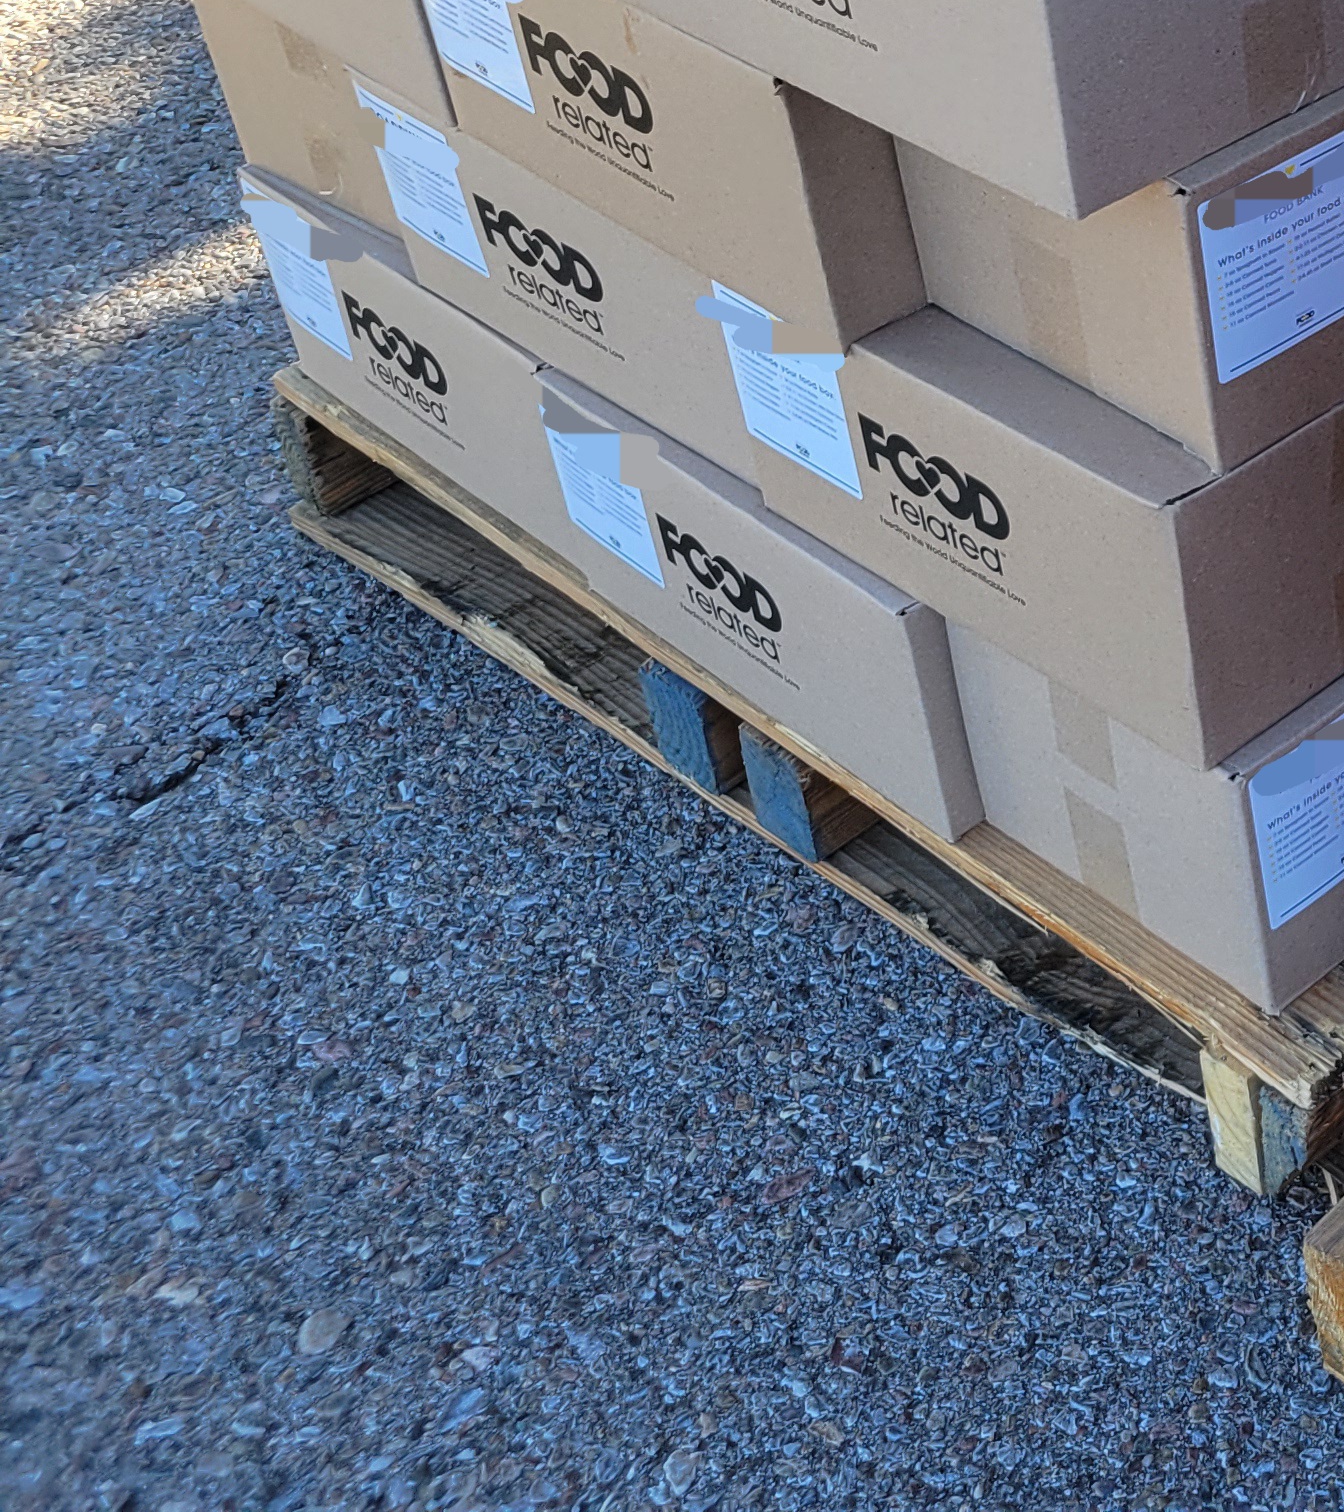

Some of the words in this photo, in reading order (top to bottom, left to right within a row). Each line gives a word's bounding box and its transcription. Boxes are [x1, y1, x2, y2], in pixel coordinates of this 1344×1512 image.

[518, 13, 653, 134] FOOD
[553, 95, 653, 172] related
[472, 193, 603, 302] FOOD
[1217, 246, 1254, 268] What's
[1257, 227, 1288, 249] inside
[1291, 212, 1314, 232] your
[1317, 199, 1341, 217] food
[1263, 202, 1294, 224] FOOD
[507, 264, 604, 335] related
[341, 290, 448, 395] FOOD
[369, 357, 448, 425] related
[858, 412, 1010, 540] FOOD
[655, 513, 782, 632] FOOD
[889, 491, 1003, 576] related
[686, 583, 780, 663] related
